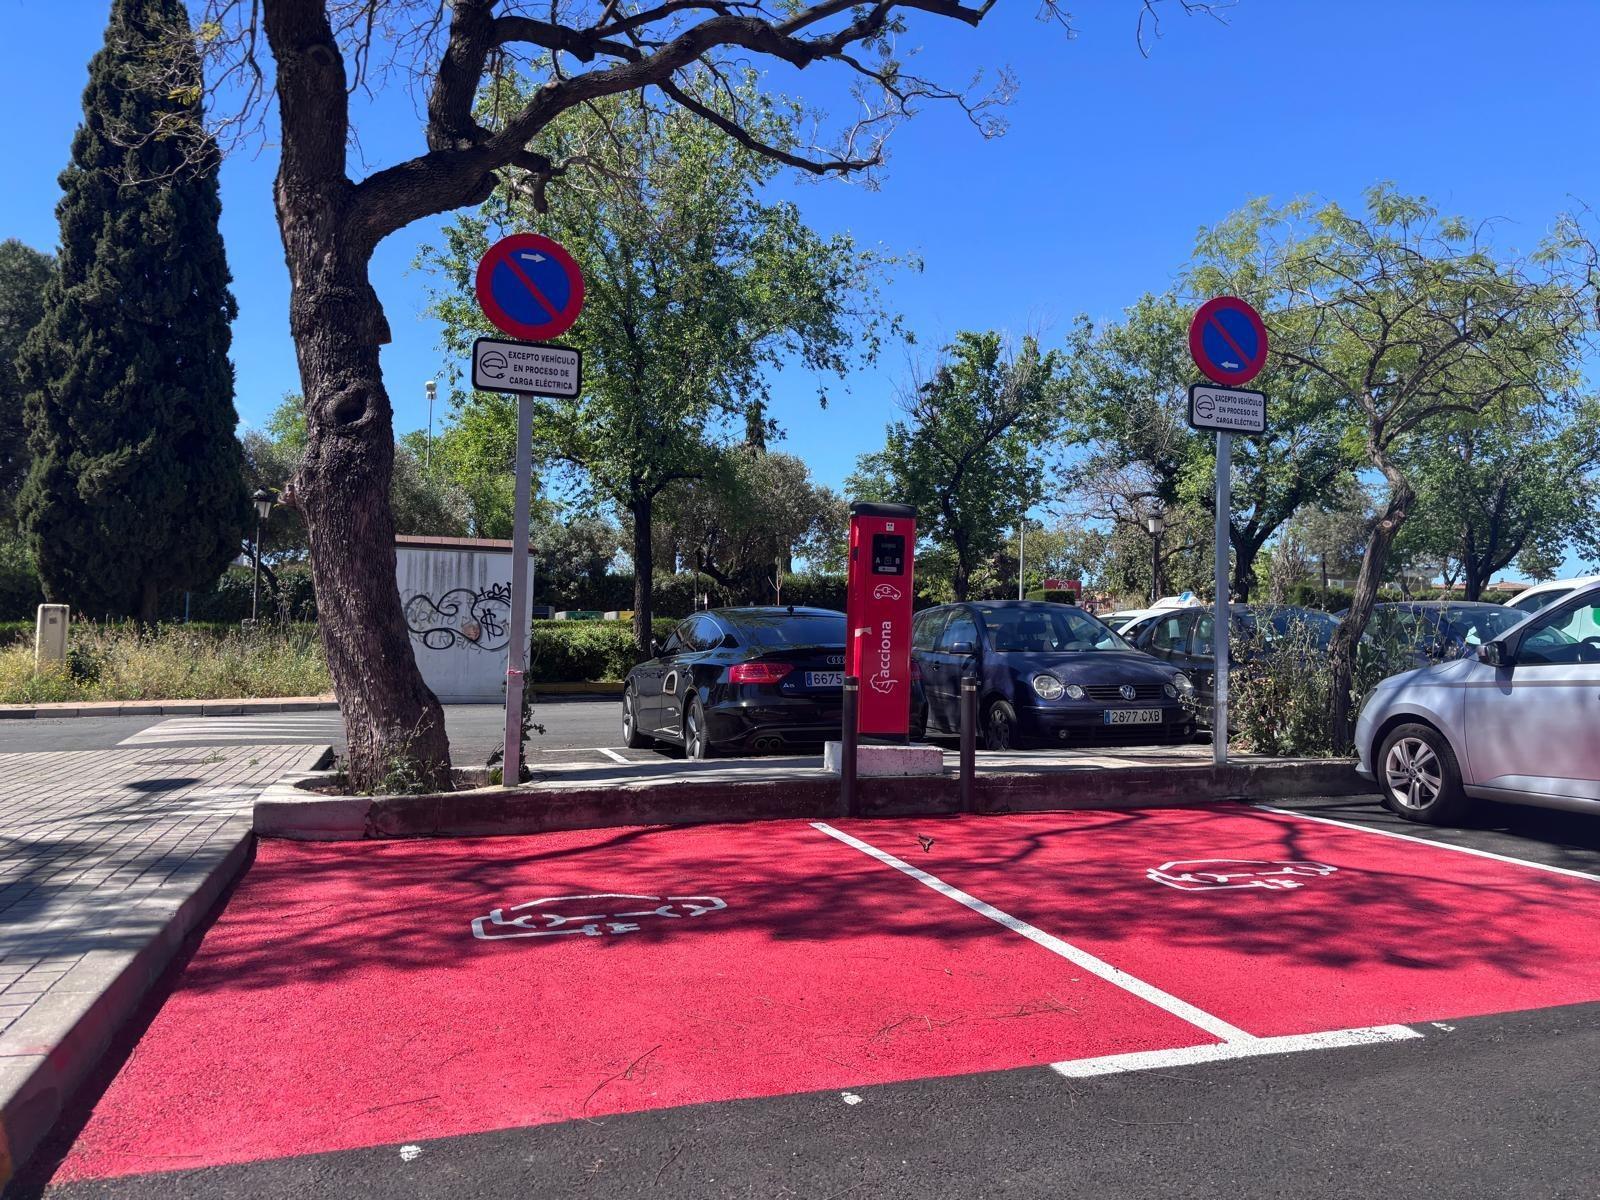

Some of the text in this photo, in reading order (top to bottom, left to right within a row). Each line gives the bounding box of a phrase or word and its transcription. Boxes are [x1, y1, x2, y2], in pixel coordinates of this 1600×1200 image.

[508, 351, 576, 366] EXCEPTO VEHÍCULO
[513, 364, 570, 377] EN PROCESO DE
[509, 376, 573, 390] CARGA ELÉCTRICA
[1215, 394, 1263, 407] EXCEPTO VEHÍCULO
[1227, 407, 1250, 416] PROCESO
[1215, 416, 1261, 427] CARGA ELÉCTRICA
[878, 621, 892, 678] acciona
[813, 673, 843, 685] 6675
[1112, 710, 1160, 723] 2877 CXB
